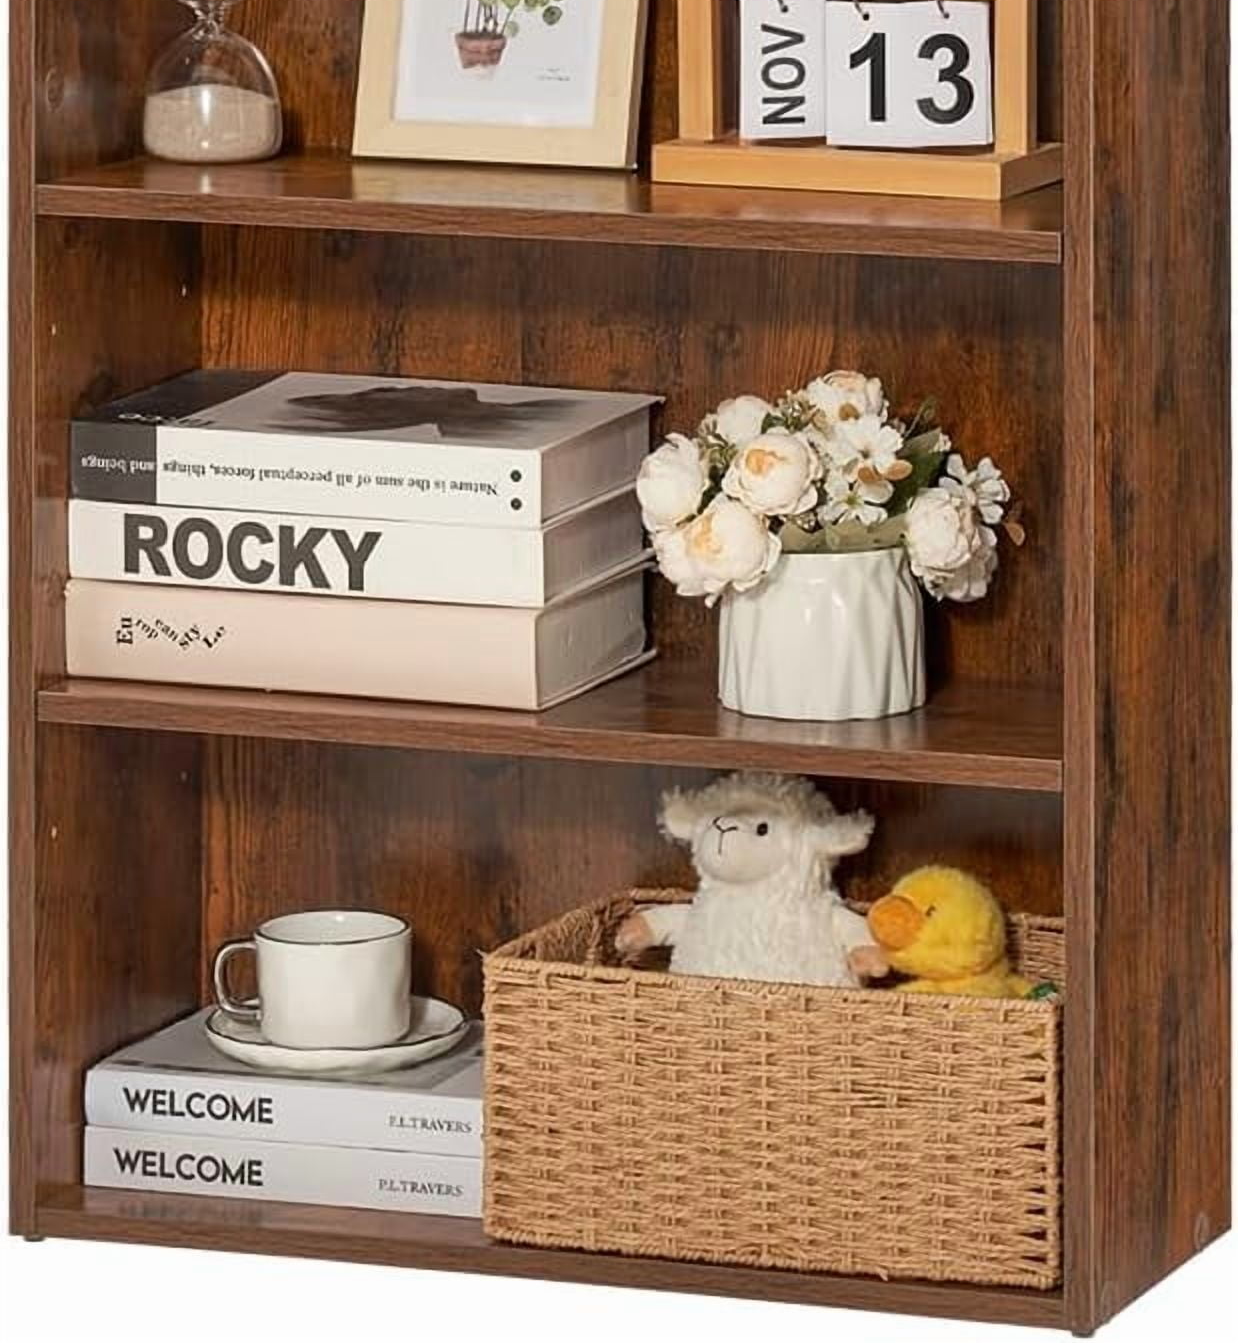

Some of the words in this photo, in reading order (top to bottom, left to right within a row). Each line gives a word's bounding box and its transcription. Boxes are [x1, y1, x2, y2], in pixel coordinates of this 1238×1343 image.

[761, 23, 806, 125] NOV
[849, 31, 975, 125] 13
[81, 454, 127, 472] beings
[130, 457, 156, 474] and
[163, 460, 206, 477] things
[210, 462, 255, 481] forces,
[259, 466, 333, 483] perceptual
[336, 473, 353, 487] all
[355, 473, 372, 488] of
[376, 475, 403, 487] sum
[407, 477, 431, 492] the
[434, 481, 446, 493] is
[450, 480, 498, 496] Nature
[123, 513, 383, 592] ROCKY
[123, 1087, 273, 1124] WELCOME
[113, 1147, 263, 1187] WELCOME
